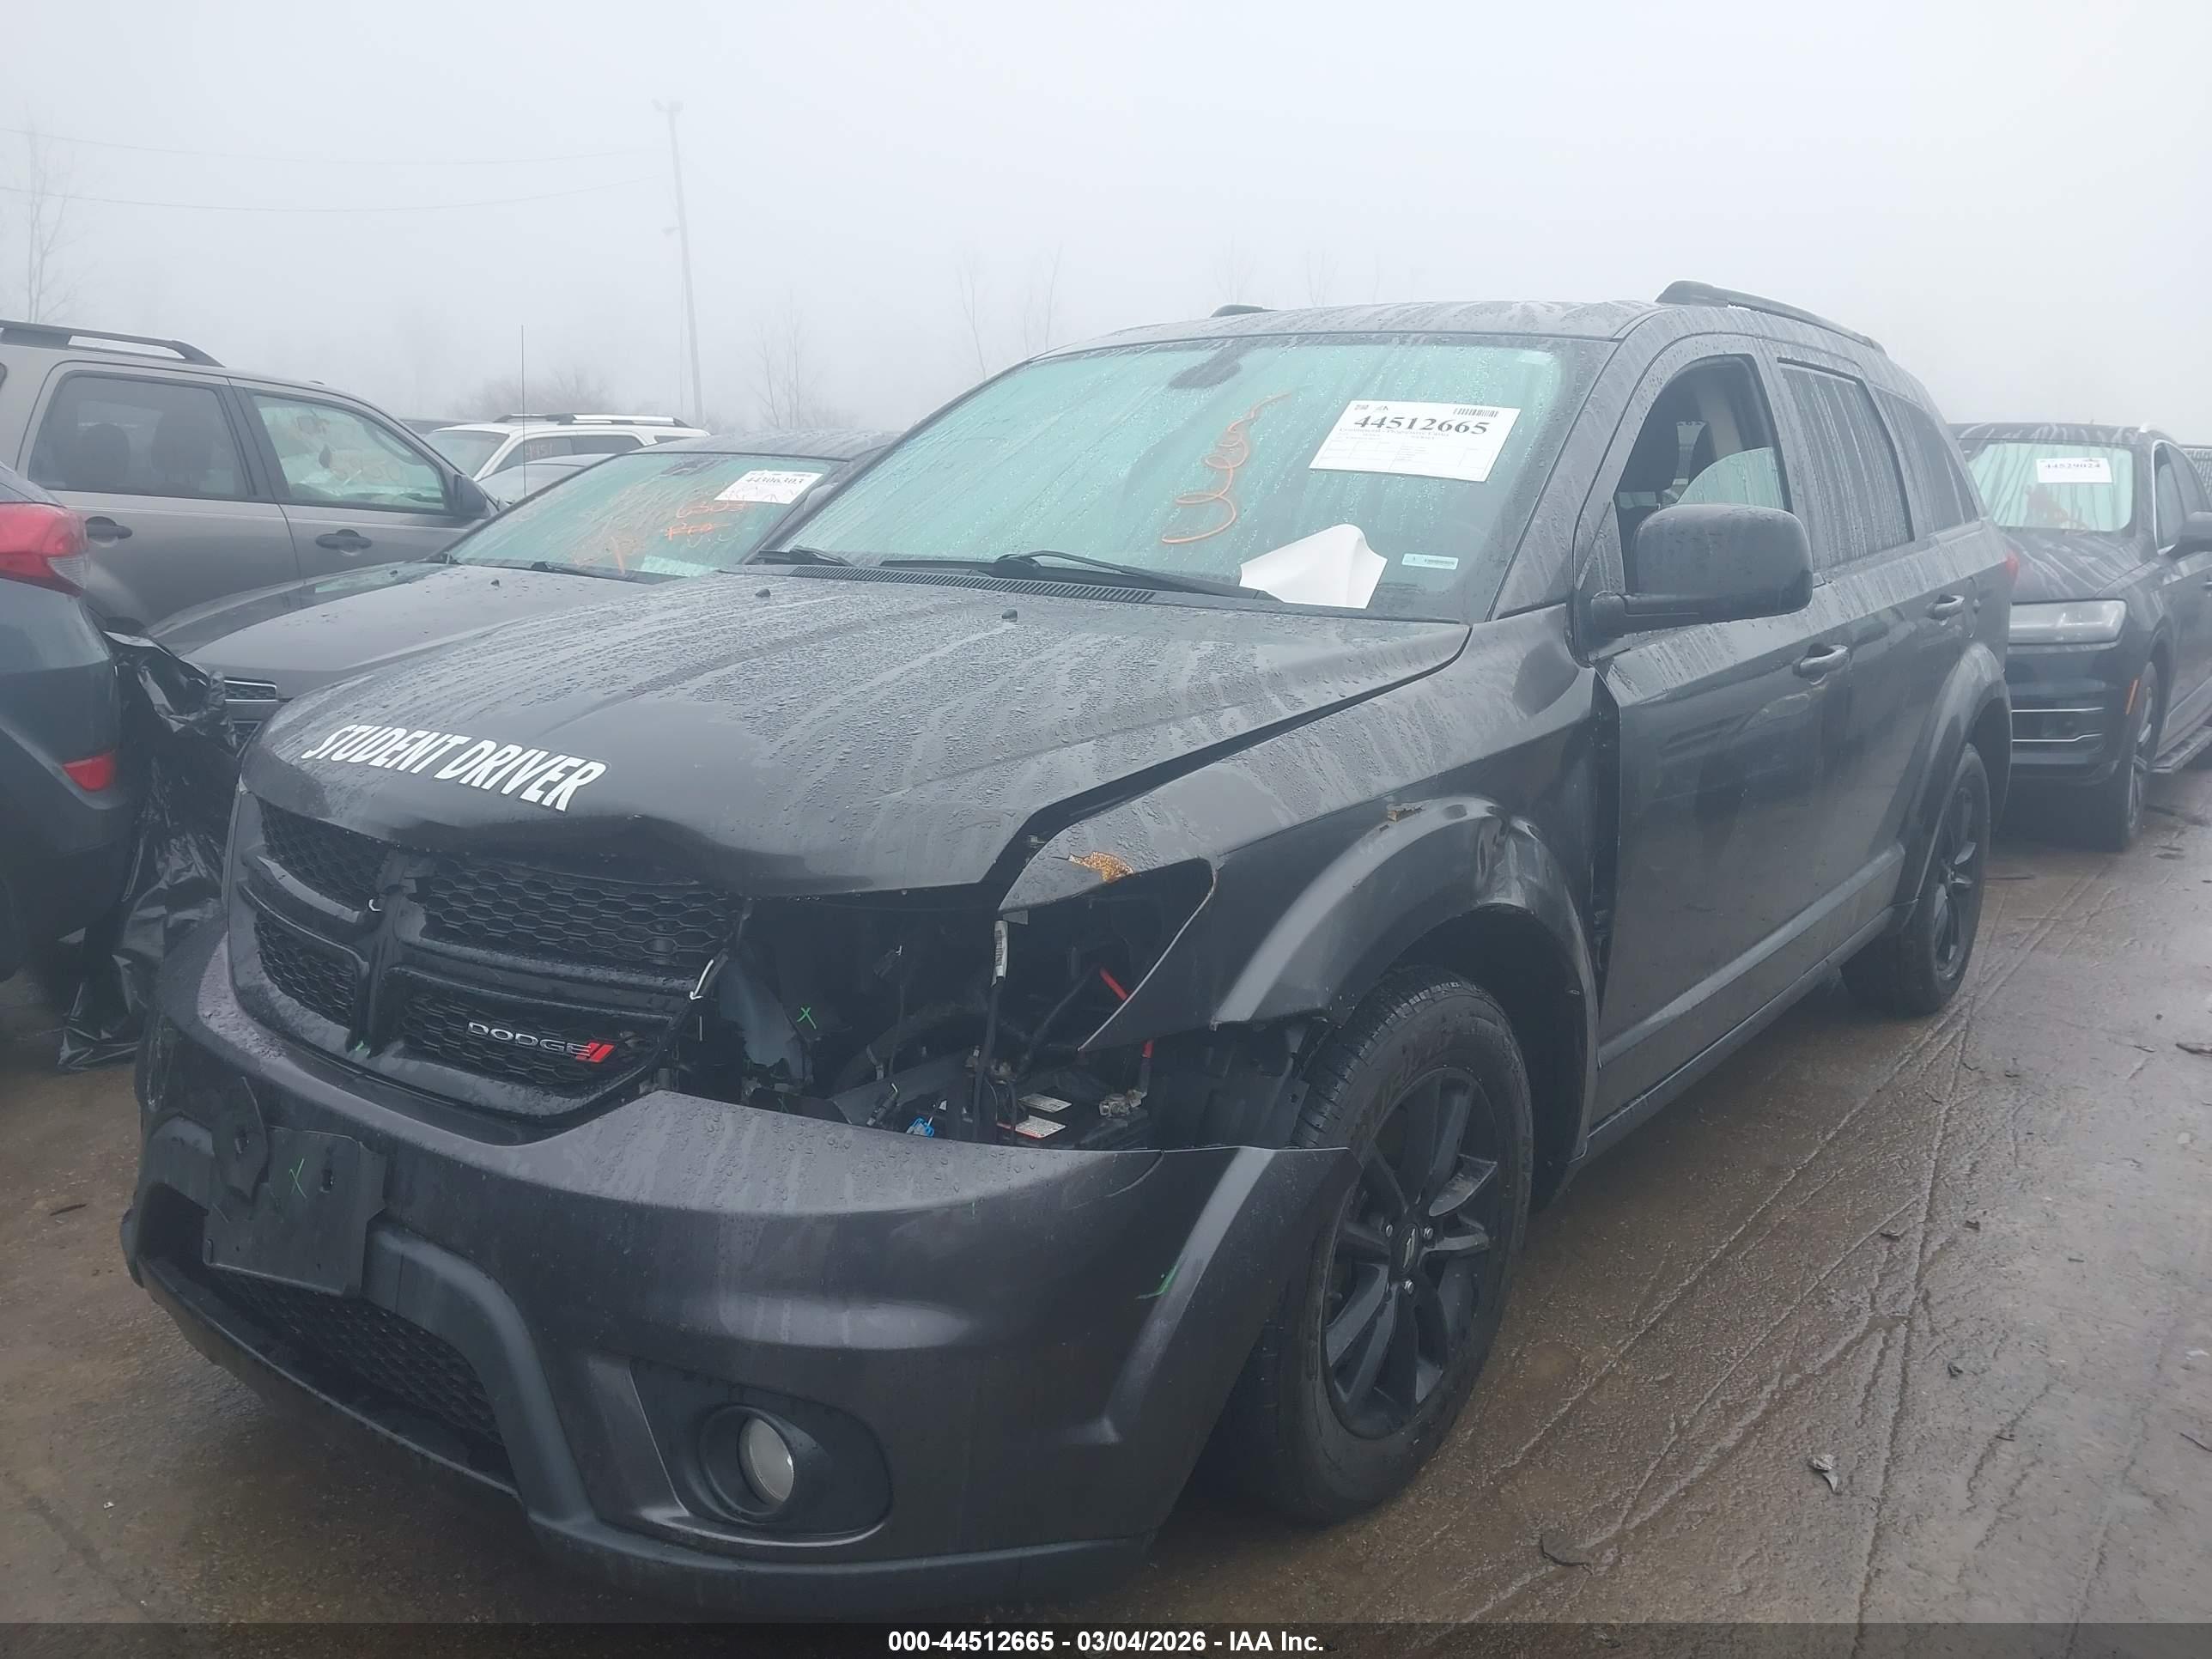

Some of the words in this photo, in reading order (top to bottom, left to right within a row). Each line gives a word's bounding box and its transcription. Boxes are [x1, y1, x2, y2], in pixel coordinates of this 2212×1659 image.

[1353, 415, 1491, 435] 44512665
[301, 724, 473, 774] STUDENT
[433, 739, 607, 812] DRIVER
[467, 1021, 592, 1057] DODGE
